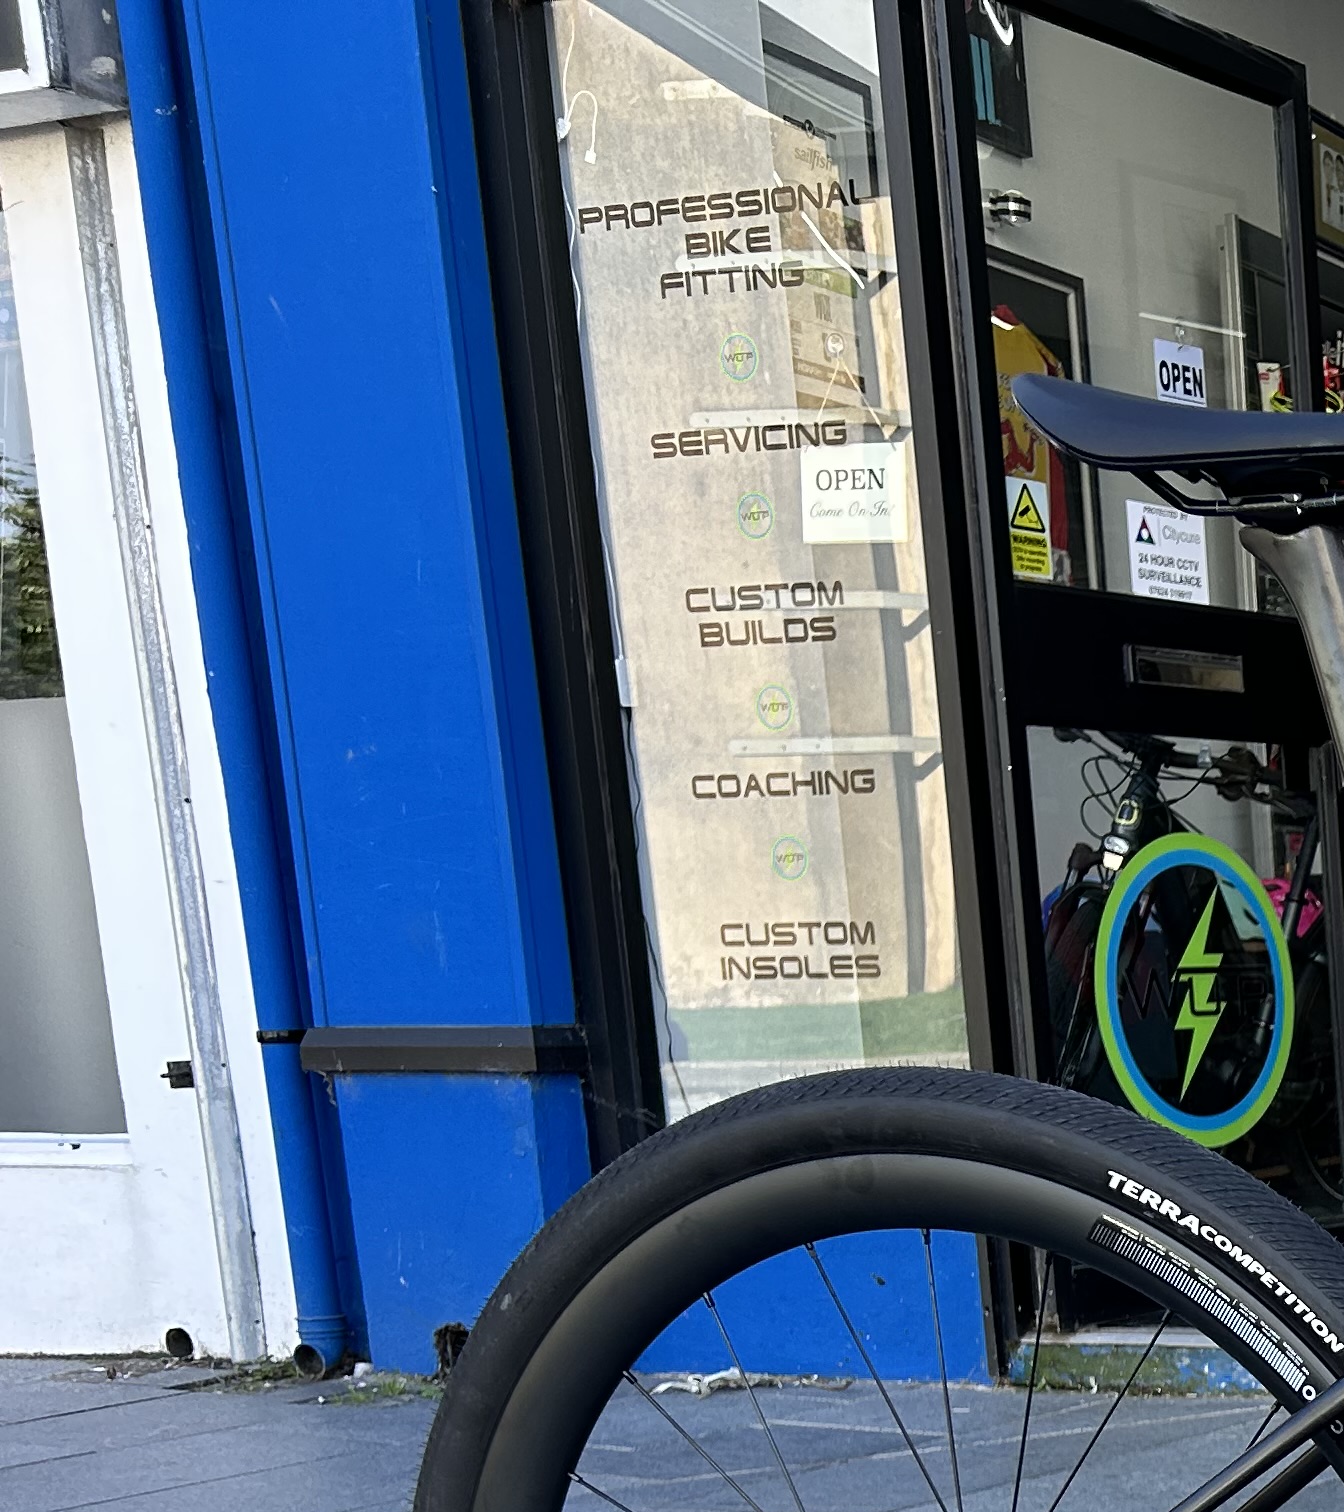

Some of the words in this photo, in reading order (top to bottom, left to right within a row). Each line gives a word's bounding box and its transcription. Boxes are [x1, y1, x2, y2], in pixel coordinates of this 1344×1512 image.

[794, 146, 832, 171] sailfish
[578, 178, 874, 234] PROFESSIONAL
[685, 227, 771, 259] BIKE
[660, 260, 804, 299] FITTING
[1159, 359, 1204, 398] OPEN
[650, 420, 848, 458] SERVICING
[815, 468, 886, 491] OPEN
[1150, 554, 1175, 568] HOUR
[1176, 557, 1200, 572] CCTV
[686, 581, 844, 613] CUSTOM
[699, 617, 837, 648] BUILDS
[691, 769, 876, 799] COACHING
[720, 921, 876, 946] CUSTOM
[721, 955, 881, 981] INSOLES
[1107, 1169, 1344, 1353] TERRACOMPETITION
